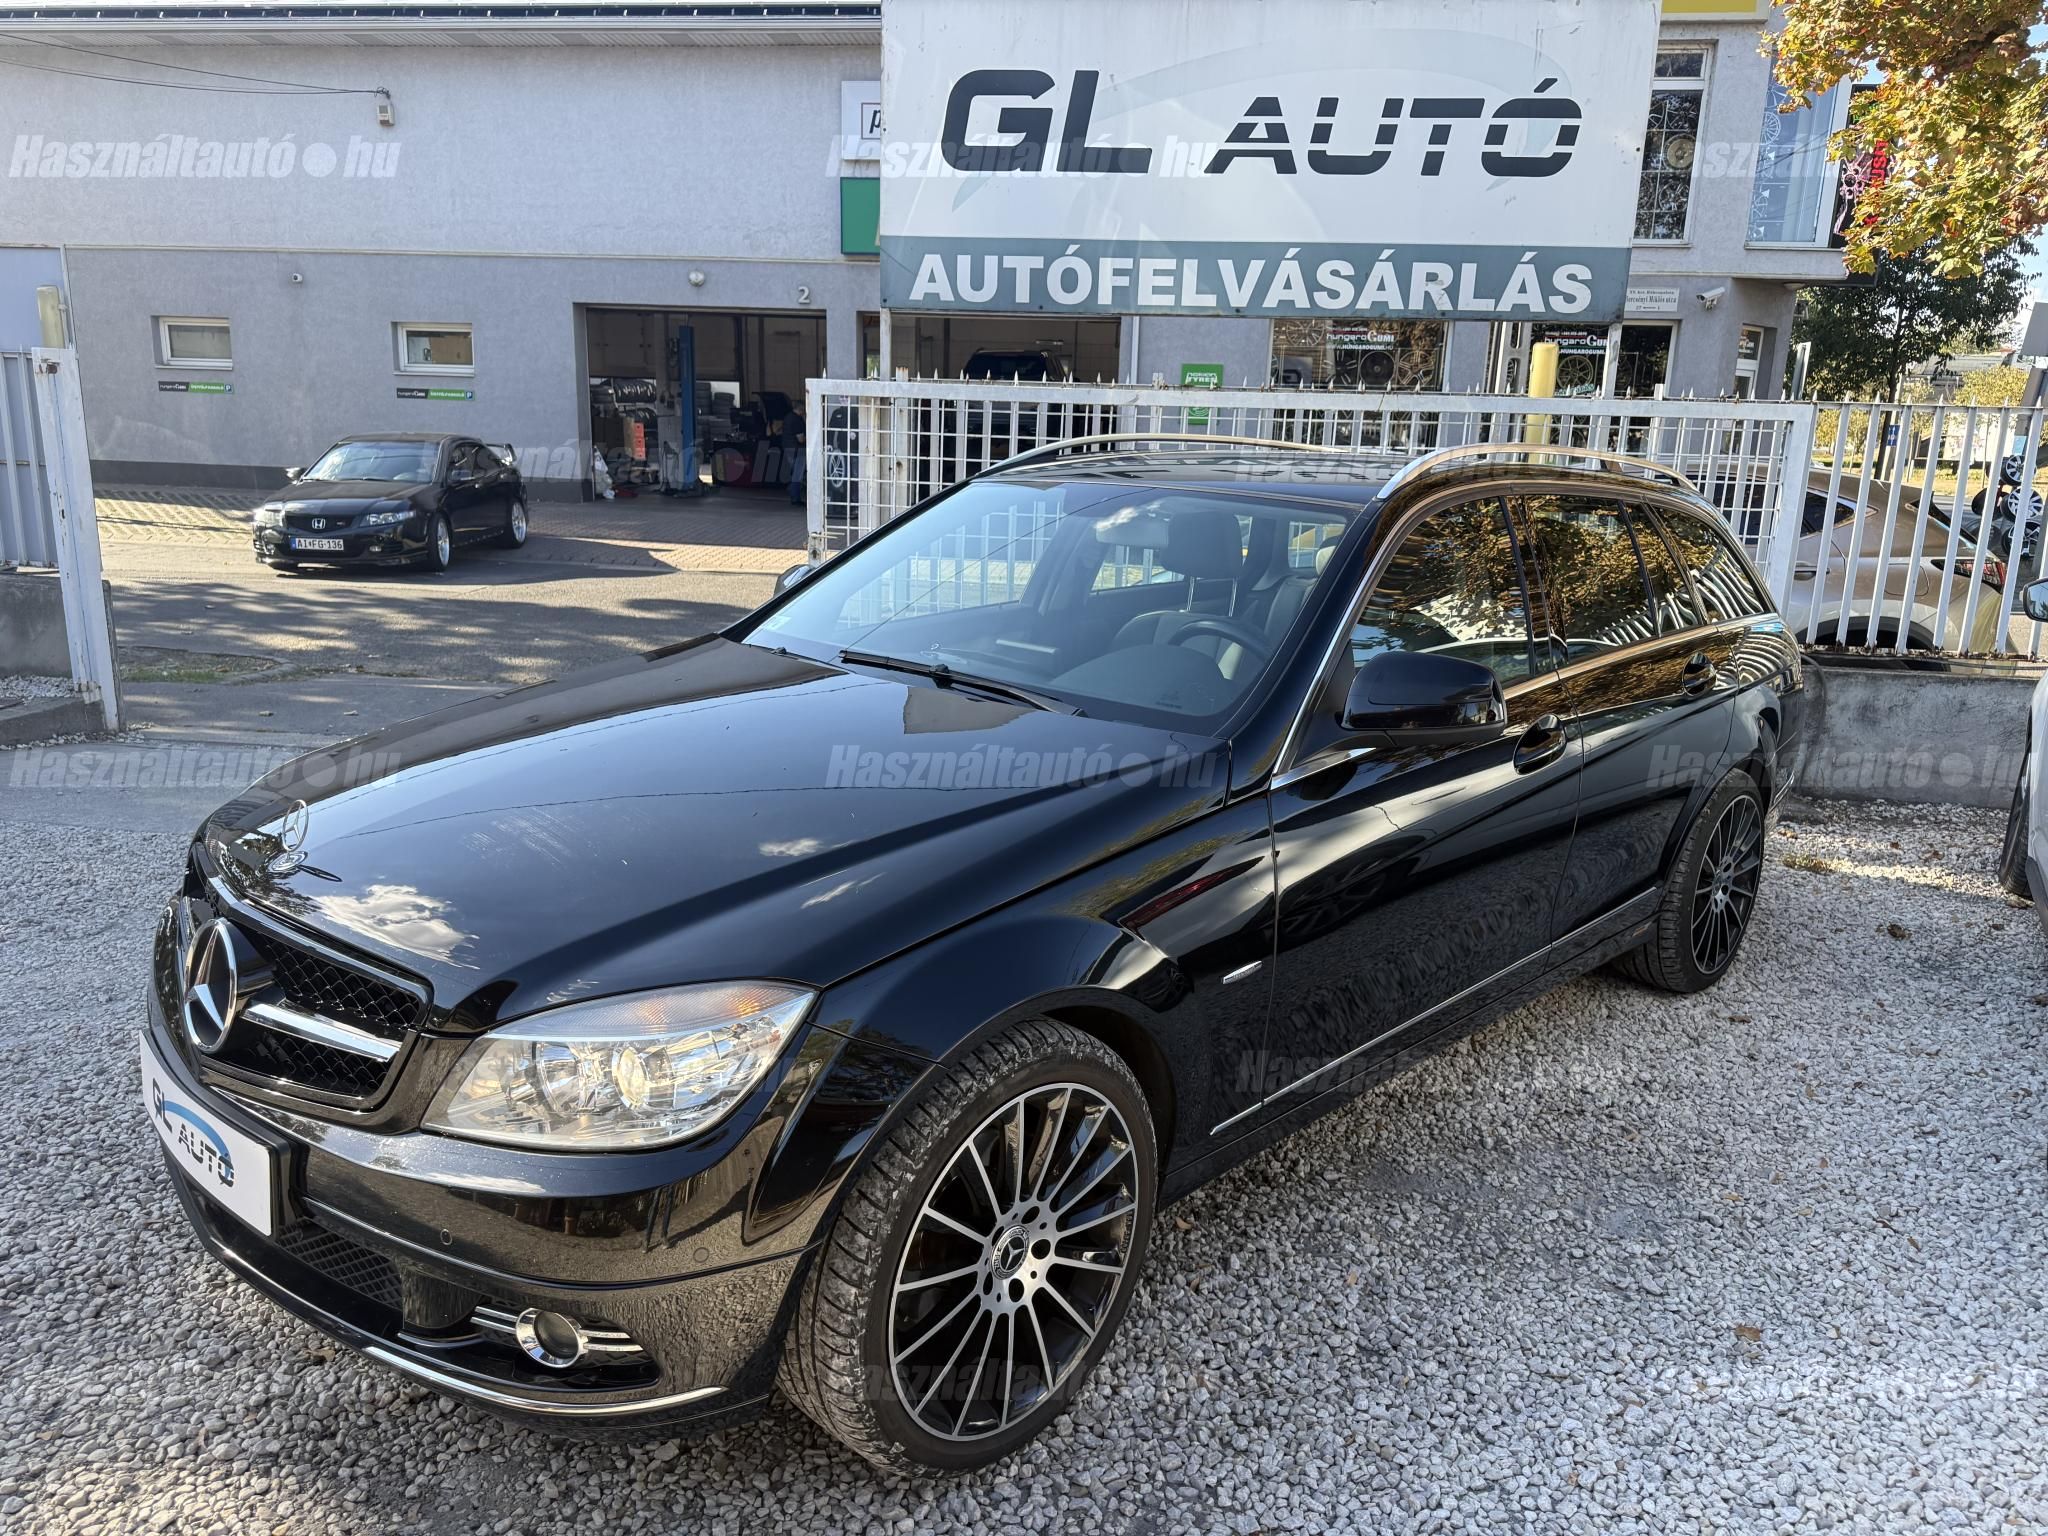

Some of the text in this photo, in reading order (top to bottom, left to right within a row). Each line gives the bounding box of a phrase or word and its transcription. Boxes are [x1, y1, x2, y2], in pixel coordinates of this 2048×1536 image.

[941, 69, 1153, 175] GL
[1204, 78, 1583, 177] AUTÓ
[798, 286, 810, 303] 2
[910, 244, 1593, 315] AUTÓFELVÁSÁRLÁS
[152, 1077, 235, 1188] GL AUTÓ
